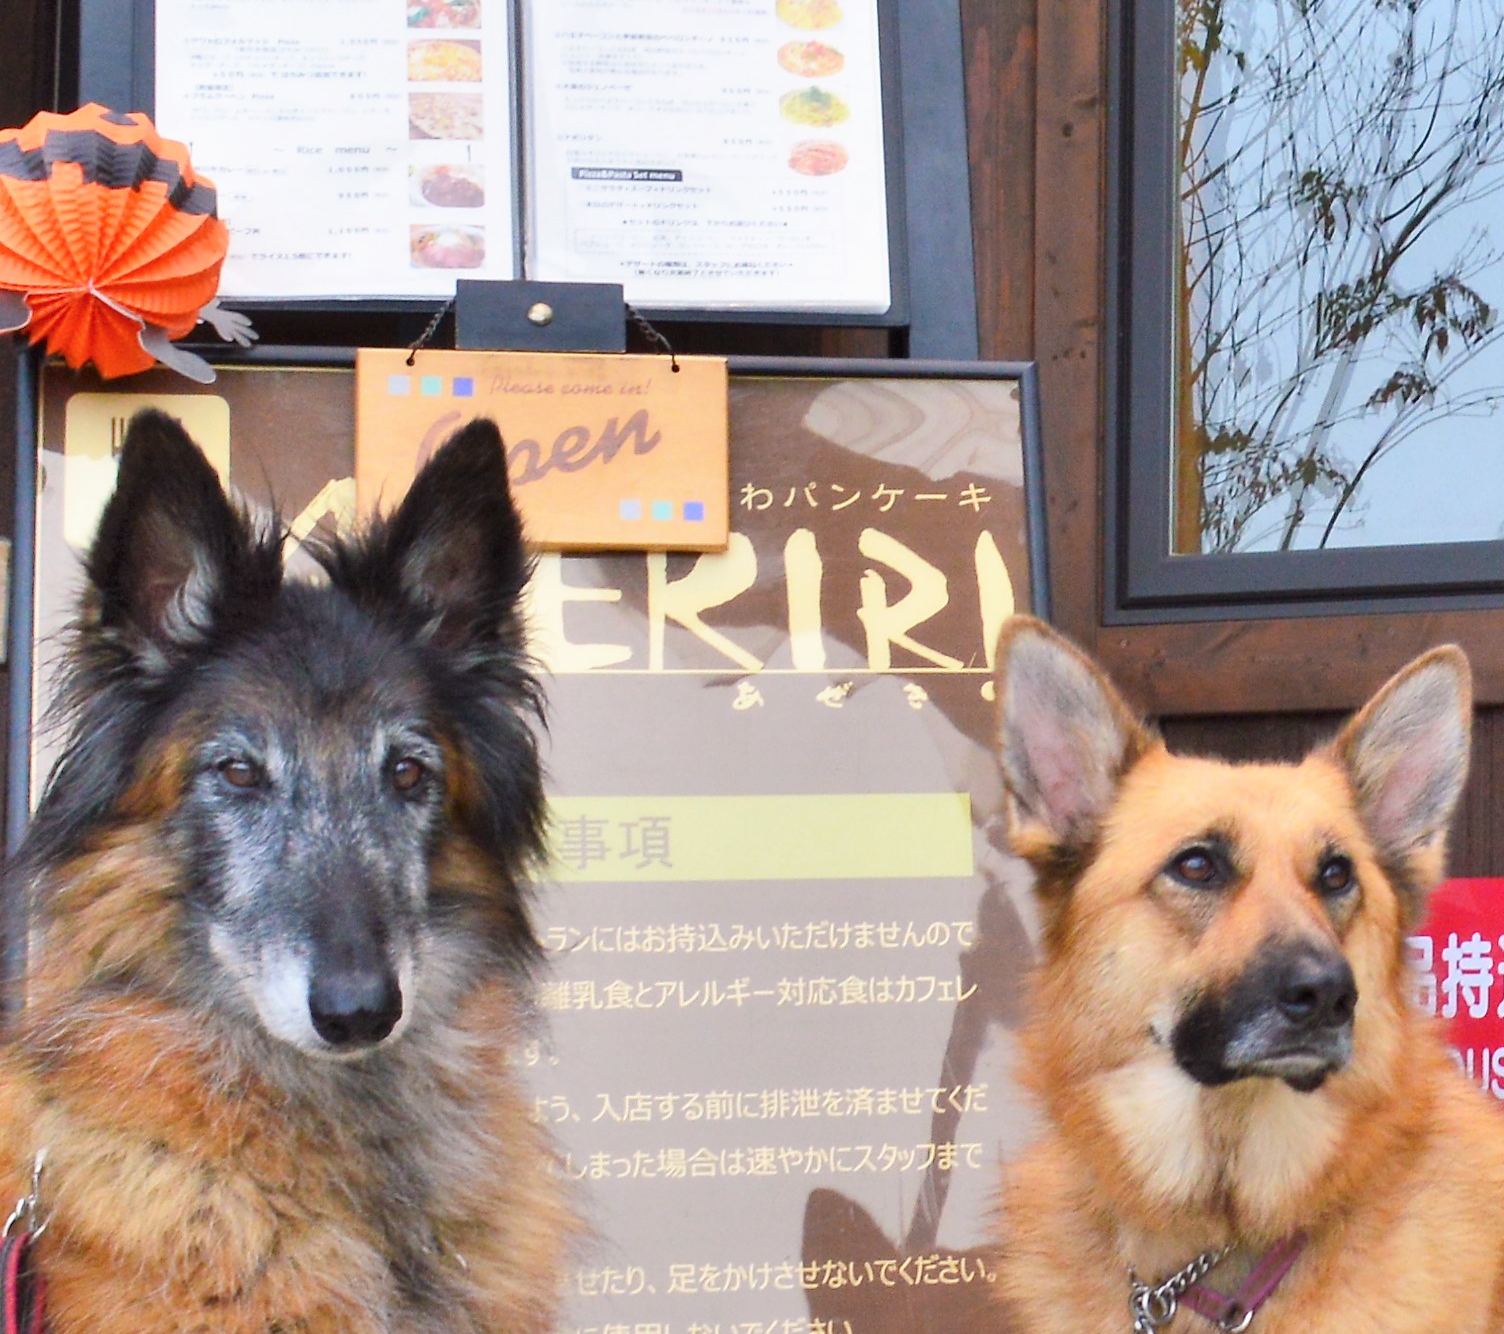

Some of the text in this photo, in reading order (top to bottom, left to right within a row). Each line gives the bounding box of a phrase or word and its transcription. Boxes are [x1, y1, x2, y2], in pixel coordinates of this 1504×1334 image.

[559, 381, 614, 396] come
[559, 814, 673, 870] 事項
[542, 921, 974, 953] ランにはお持込みいただけませんので
[554, 1142, 983, 1181] しまった場合は速やかにスタッフまで
[568, 1255, 997, 1295] せたり、足をかけさせないでください。
